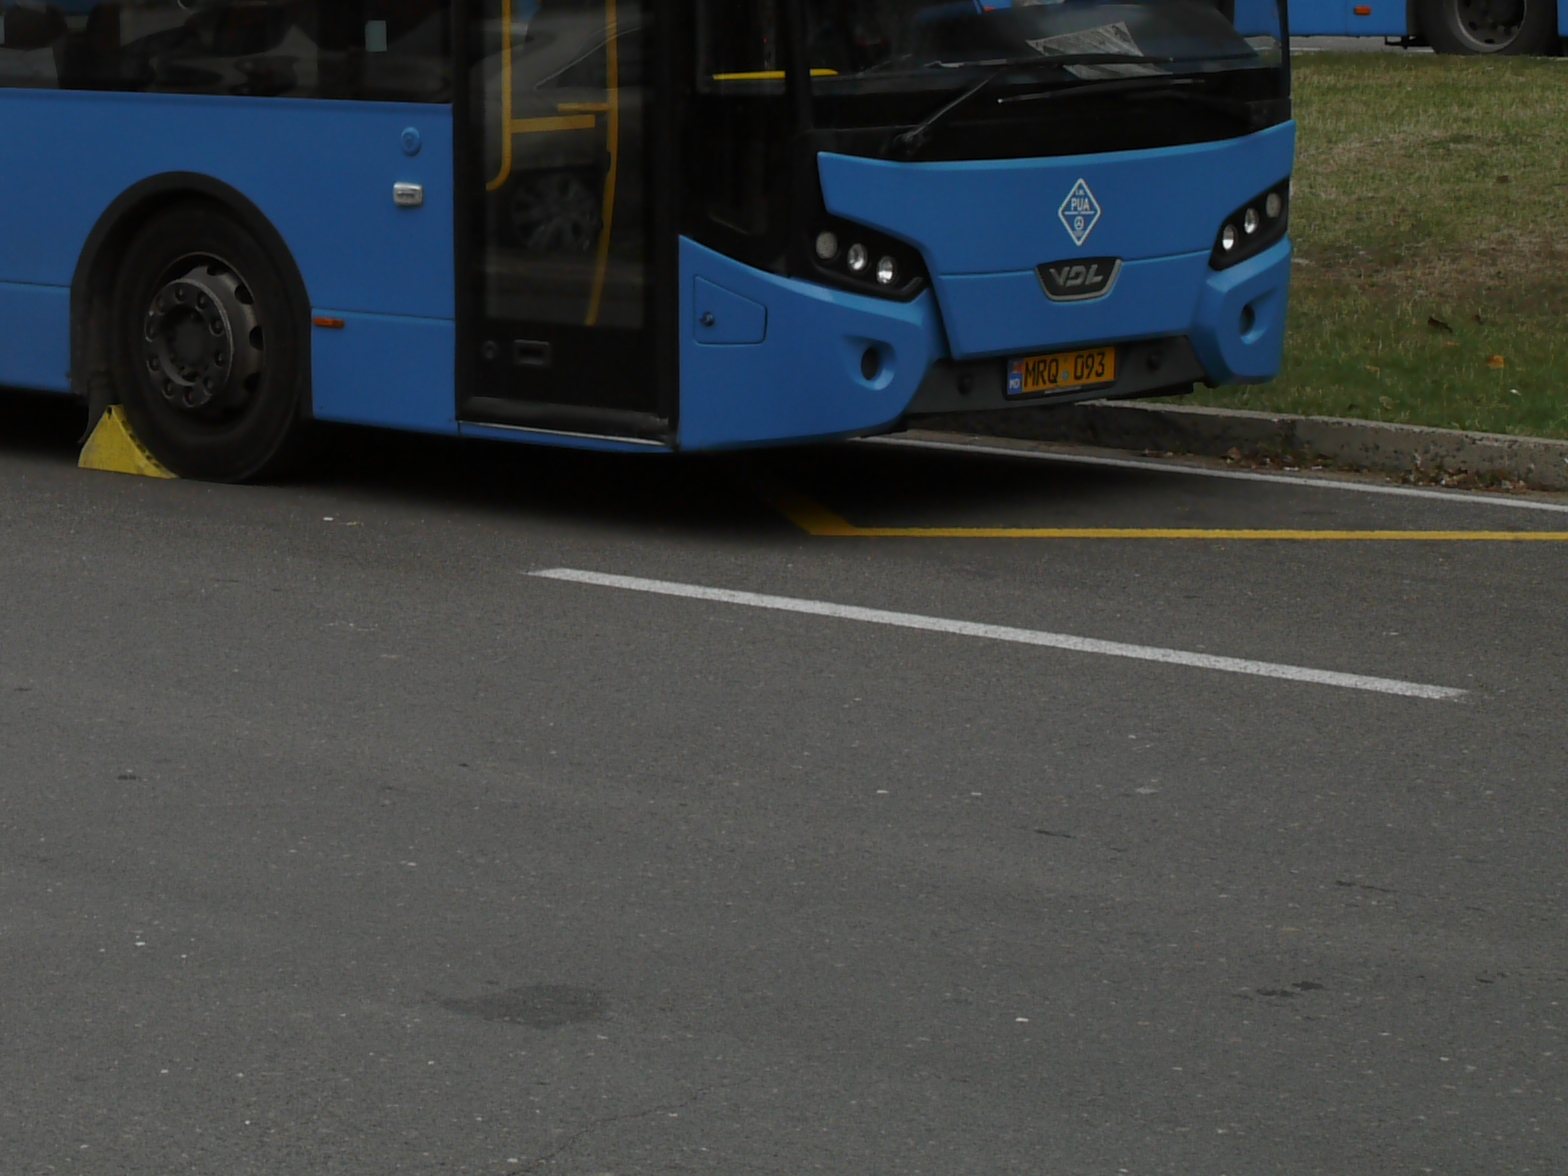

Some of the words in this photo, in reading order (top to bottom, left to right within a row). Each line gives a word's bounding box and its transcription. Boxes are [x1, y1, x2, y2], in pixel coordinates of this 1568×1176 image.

[1048, 263, 1105, 288] VDL
[1024, 358, 1060, 388] MRQ
[1074, 351, 1107, 381] 093
